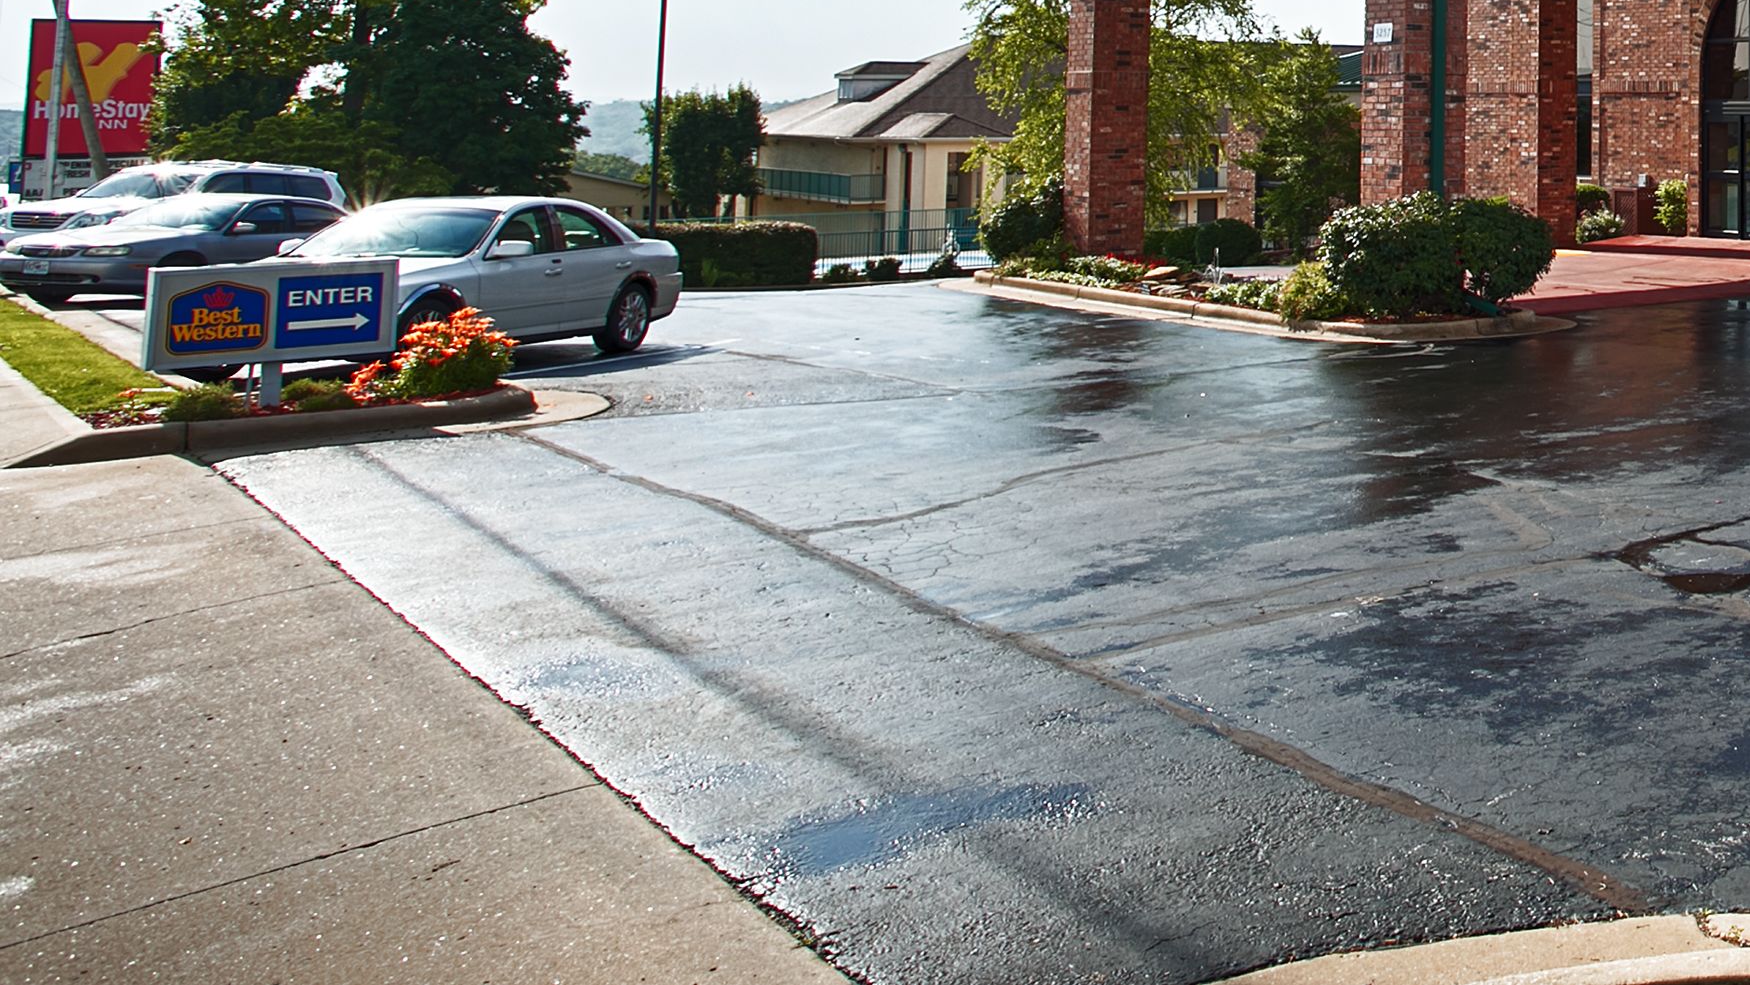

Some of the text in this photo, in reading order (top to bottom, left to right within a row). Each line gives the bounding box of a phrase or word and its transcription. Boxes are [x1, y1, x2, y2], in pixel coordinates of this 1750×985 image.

[97, 119, 128, 129] NN
[287, 286, 373, 308] ENTER
[191, 306, 242, 327] Best
[171, 322, 262, 343] Western
